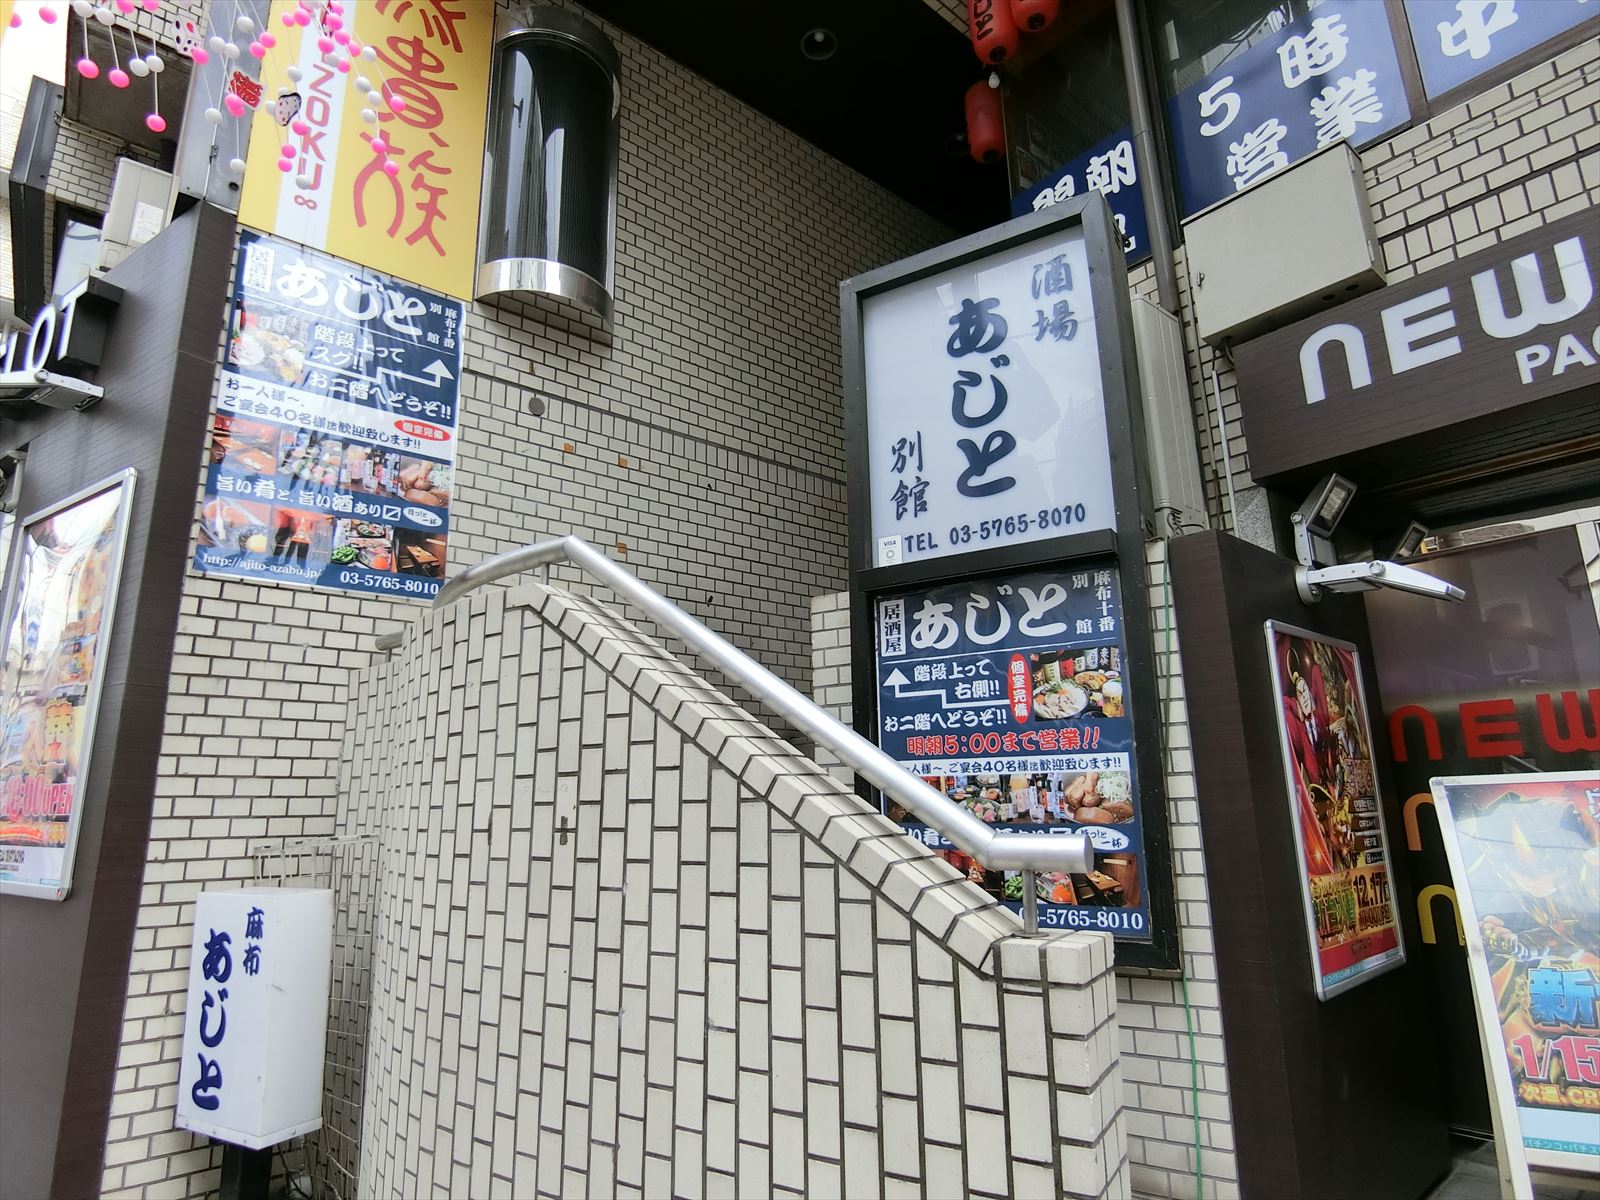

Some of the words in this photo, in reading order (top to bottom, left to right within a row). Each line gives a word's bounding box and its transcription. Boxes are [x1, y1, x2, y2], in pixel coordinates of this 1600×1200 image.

[277, 258, 427, 336] あじと
[1031, 254, 1078, 342] 酒場
[314, 324, 405, 363] 階段上って
[1515, 325, 1600, 385] PA
[947, 298, 1016, 498] あじと
[889, 430, 930, 521] 別館
[904, 532, 938, 553] TEL
[949, 503, 1086, 546] 03-5765-8010
[340, 570, 440, 595] 03-5765-8010
[1072, 573, 1093, 635] 別館
[1094, 570, 1115, 632] 麻布十番
[884, 604, 902, 654] 居酒屋
[911, 583, 1067, 650] あじと
[914, 659, 991, 682] 階段上って
[1010, 660, 1028, 717] 個室完備
[243, 906, 265, 976] 麻布
[1019, 907, 1143, 929] -5765-8010
[192, 928, 233, 1110] あじと
